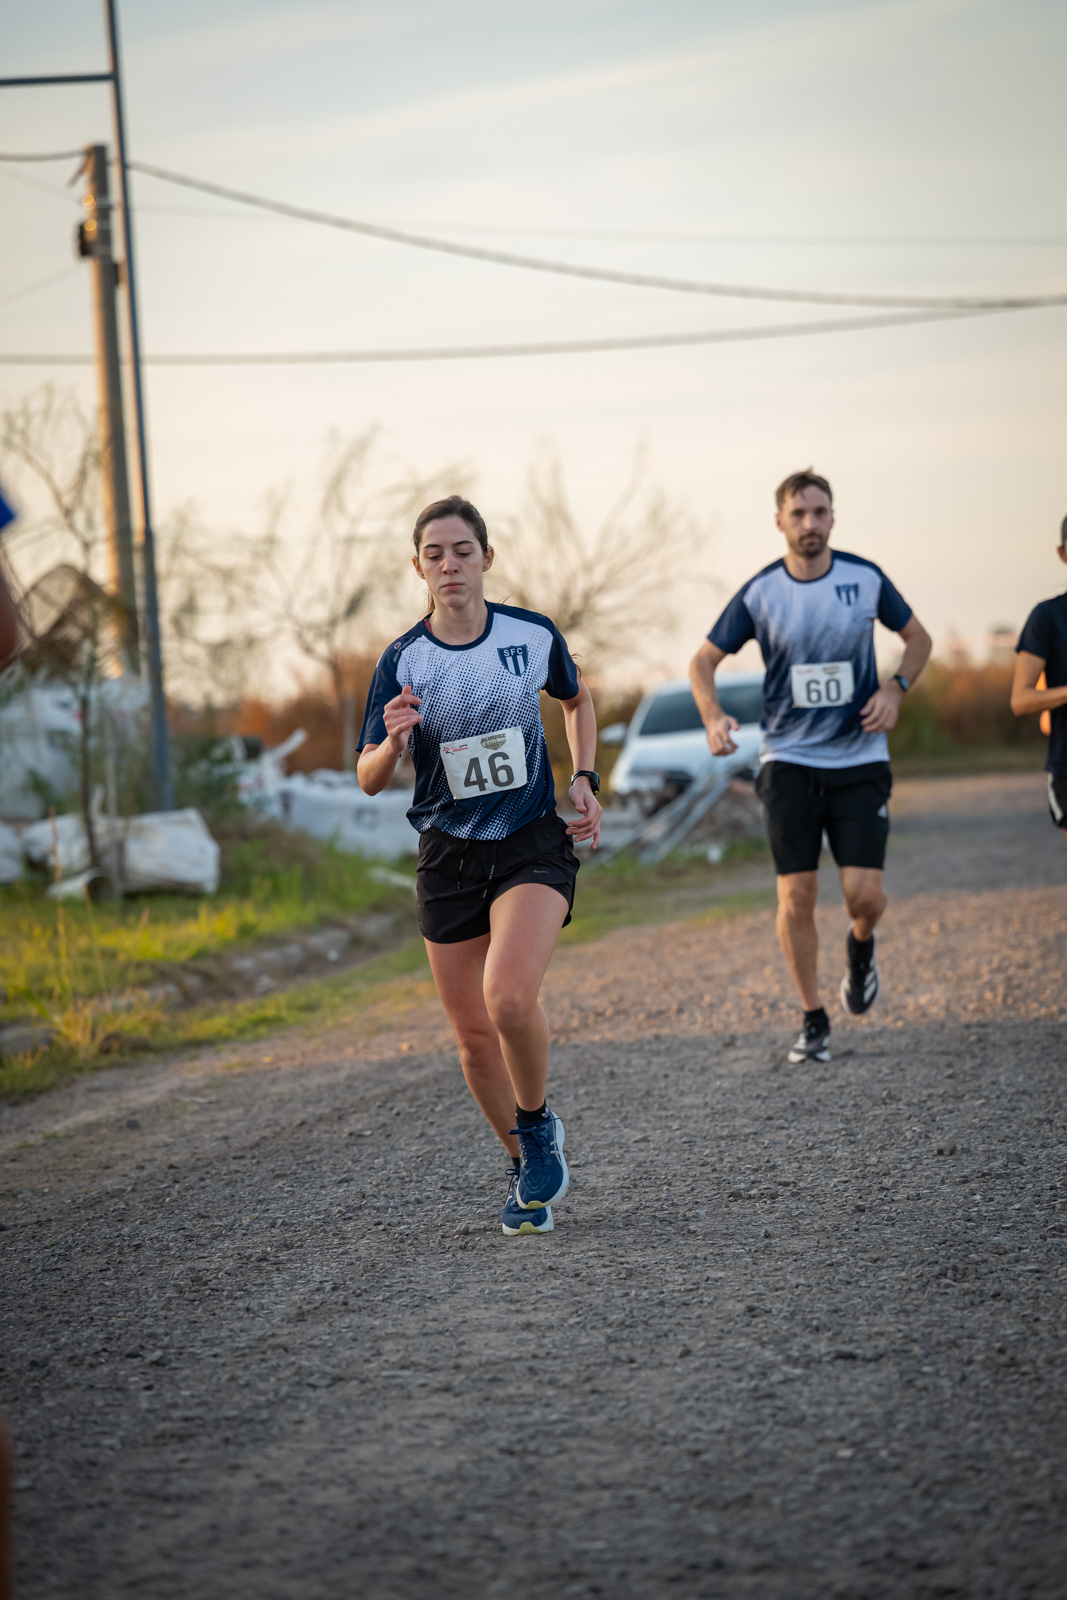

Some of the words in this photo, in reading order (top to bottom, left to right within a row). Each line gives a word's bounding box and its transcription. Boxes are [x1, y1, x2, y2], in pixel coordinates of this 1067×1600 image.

[503, 647, 523, 657] SFC
[806, 678, 841, 704] 60
[463, 751, 515, 792] 46
